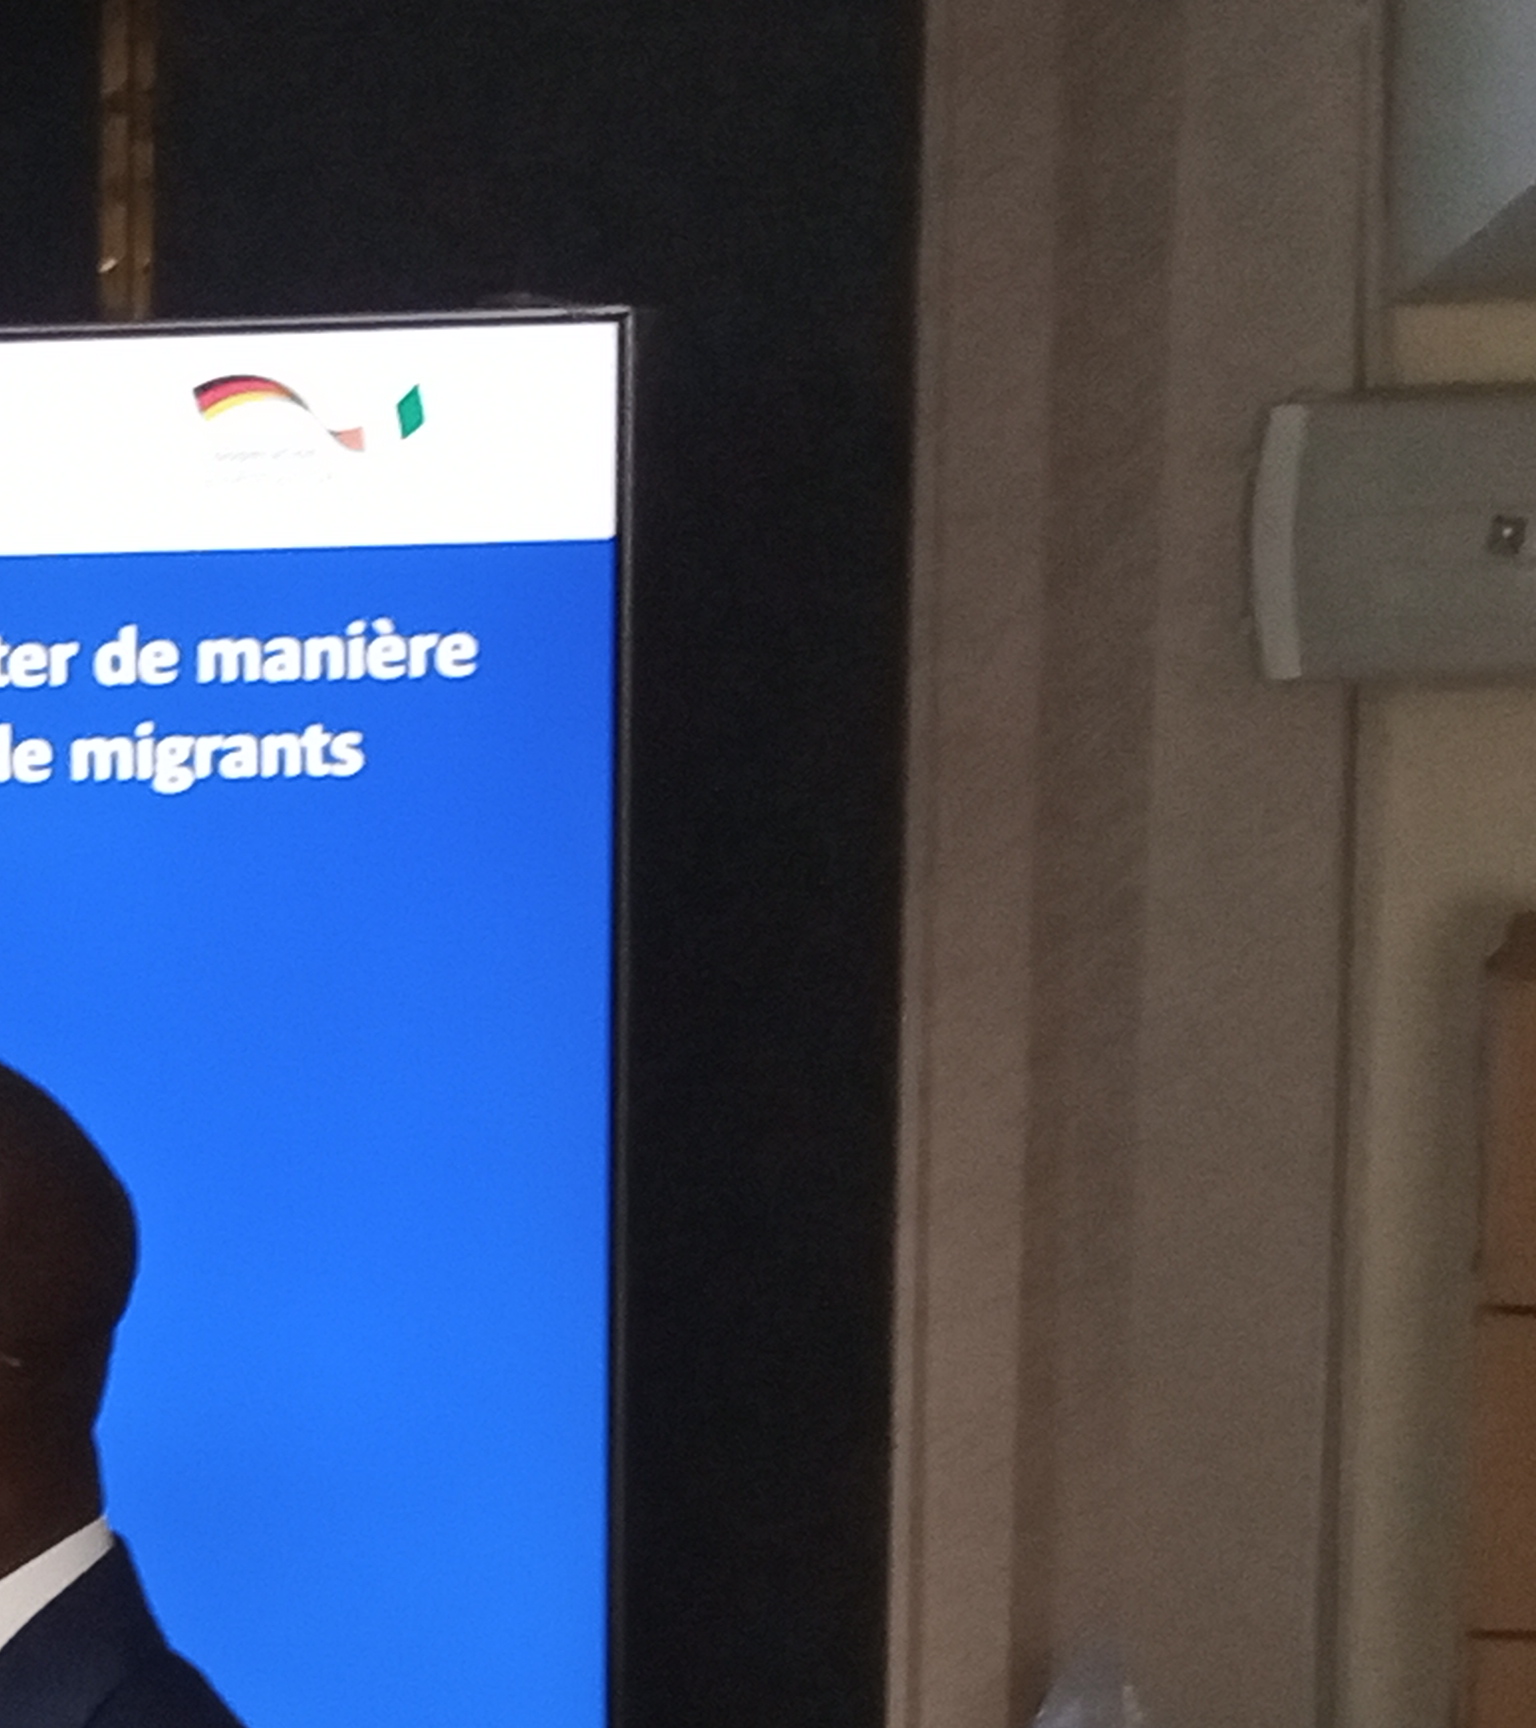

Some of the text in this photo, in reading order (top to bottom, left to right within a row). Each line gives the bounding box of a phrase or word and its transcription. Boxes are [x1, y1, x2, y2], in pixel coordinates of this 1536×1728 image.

[94, 625, 179, 686] de
[197, 618, 477, 683] manière
[71, 722, 364, 793] migrants
